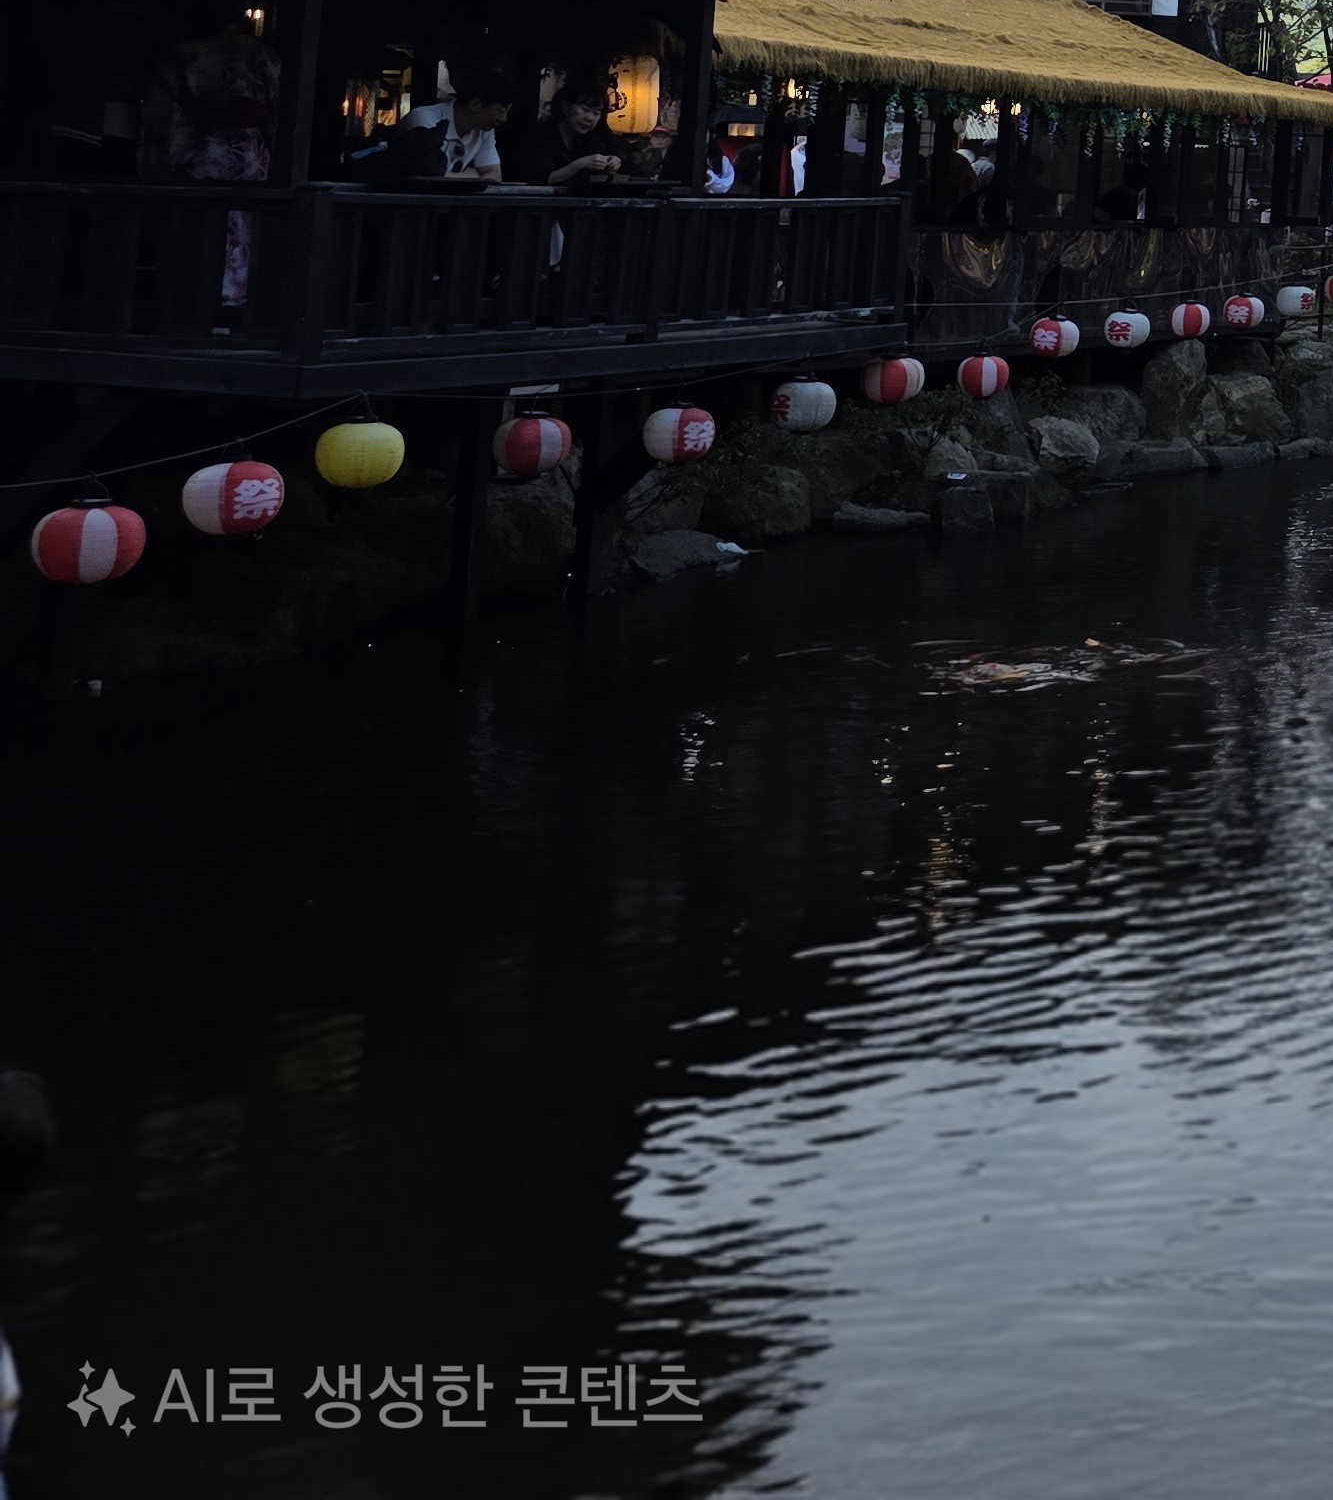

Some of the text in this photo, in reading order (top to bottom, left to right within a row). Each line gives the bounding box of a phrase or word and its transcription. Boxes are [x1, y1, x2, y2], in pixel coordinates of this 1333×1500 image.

[1227, 304, 1250, 324] 祭
[1032, 327, 1059, 351] 祭
[1107, 319, 1132, 341] 祭
[683, 419, 714, 452] 祭
[233, 478, 281, 520] 祭
